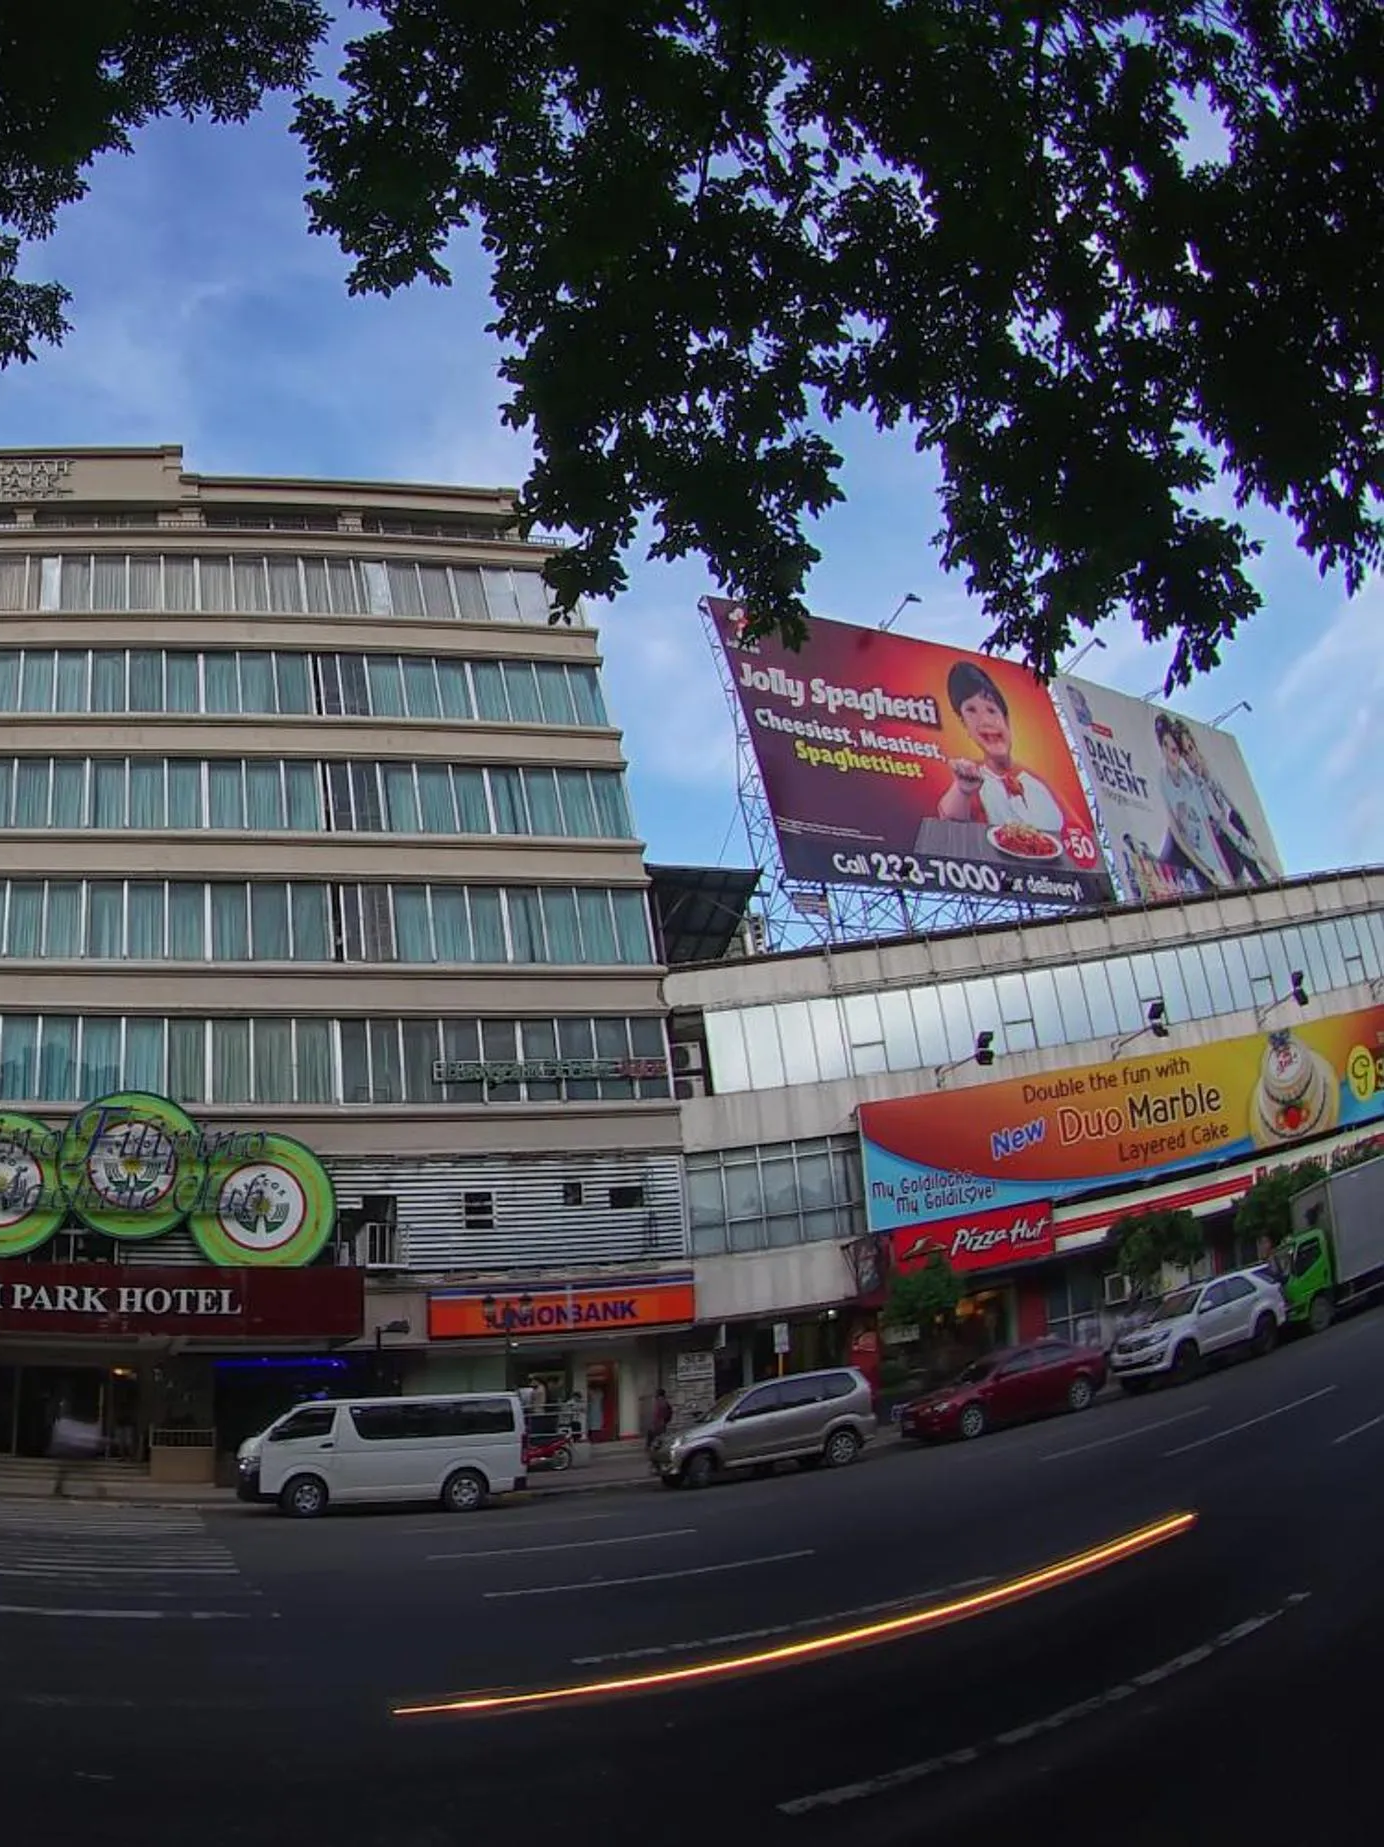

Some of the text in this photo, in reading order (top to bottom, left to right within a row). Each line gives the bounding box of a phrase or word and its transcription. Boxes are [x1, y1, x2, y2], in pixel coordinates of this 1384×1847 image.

[739, 662, 938, 725] Jolly Spaghetti
[754, 707, 947, 762] Cheesiest, Meatiest,
[1083, 735, 1133, 772] DAILY
[794, 739, 924, 779] Spaghettiest
[1091, 760, 1149, 799] SCENT
[832, 852, 870, 876] Call
[1023, 1056, 1190, 1104] Double the fun with
[991, 1083, 1221, 1160] New Duo Marble
[1118, 1121, 1229, 1164] Layered Cake
[872, 1180, 895, 1199] My
[896, 1197, 919, 1217] My
[950, 1217, 1053, 1257] Pizza Hut
[12, 1284, 109, 1313] PARK
[118, 1287, 243, 1316] HOTEL
